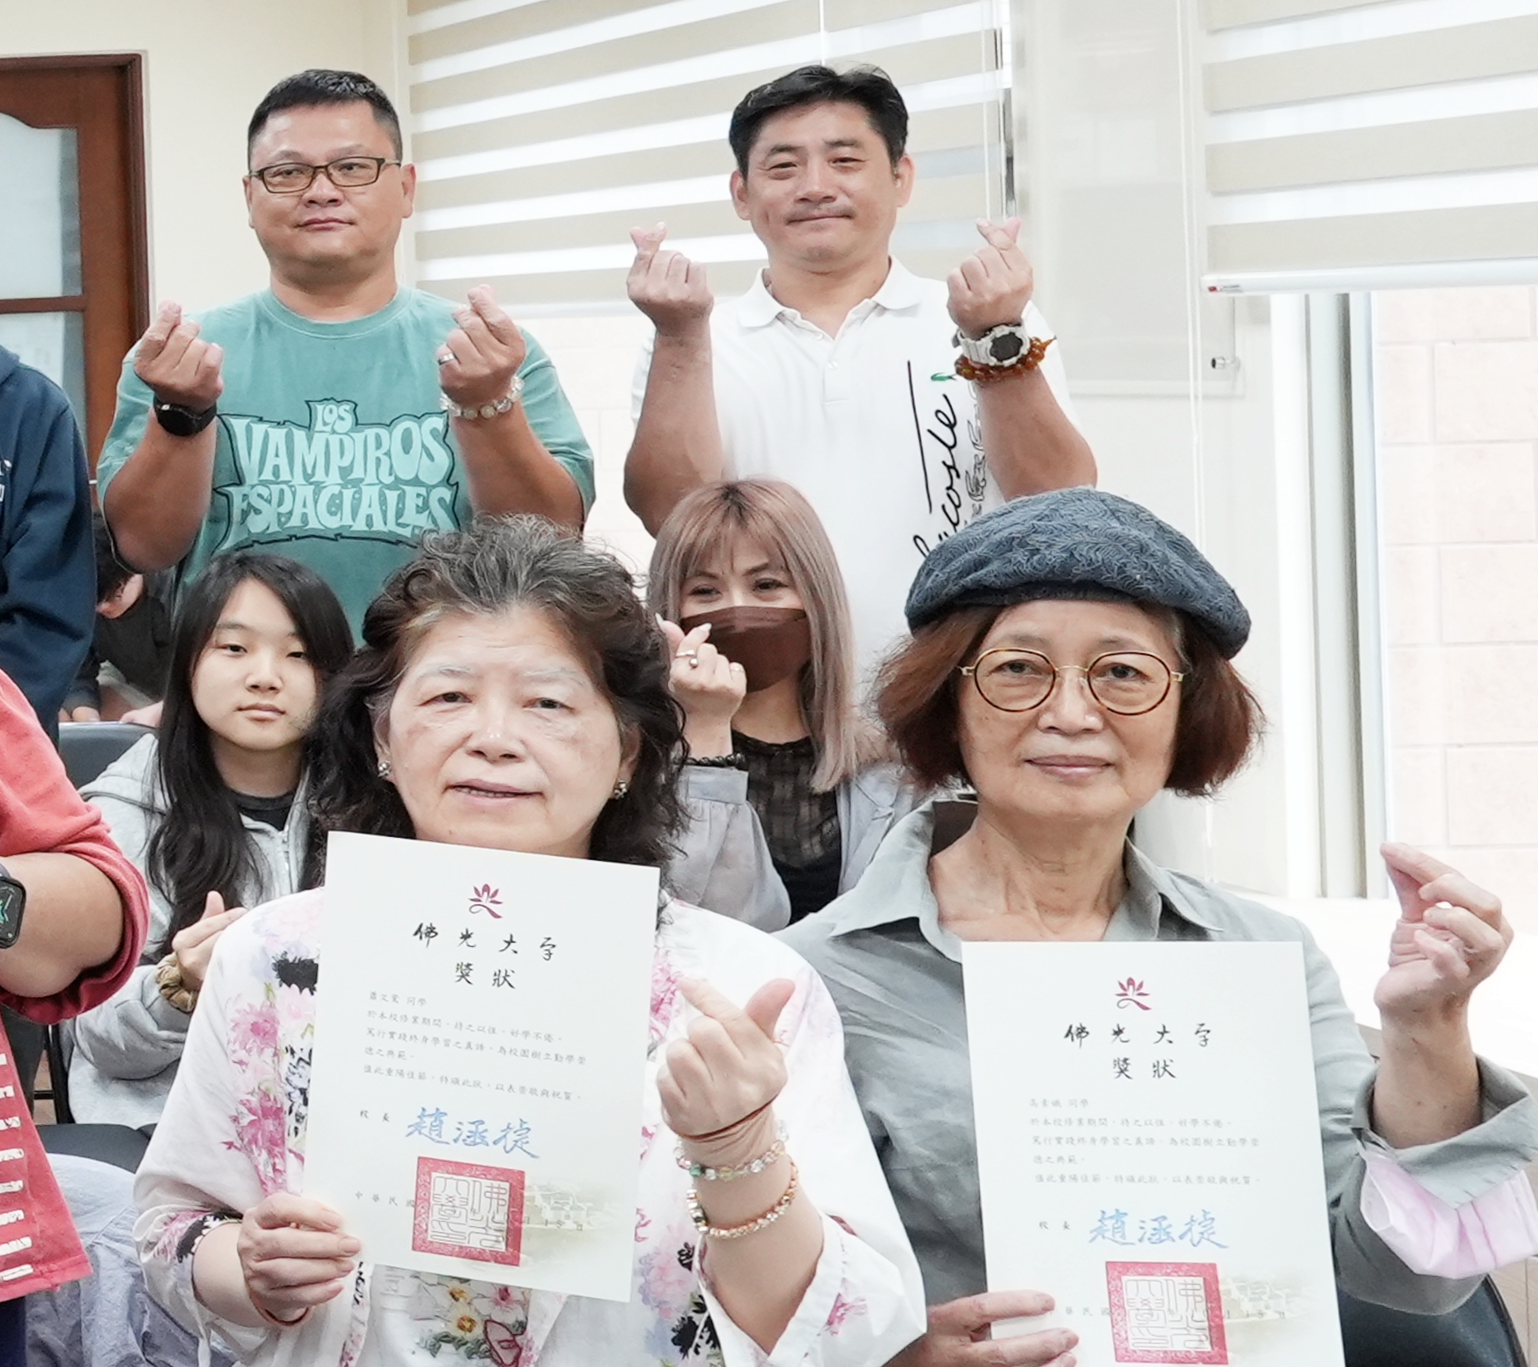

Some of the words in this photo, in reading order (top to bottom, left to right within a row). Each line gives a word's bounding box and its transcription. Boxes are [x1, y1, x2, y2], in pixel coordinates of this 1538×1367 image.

[315, 403, 354, 433] LOS
[229, 416, 450, 485] VAMPIROS
[219, 483, 454, 551] ESPACIALES
[454, 961, 517, 989] 獎狀
[1112, 1056, 1177, 1080] 獎狀
[1050, 1306, 1110, 1317] 華民國
